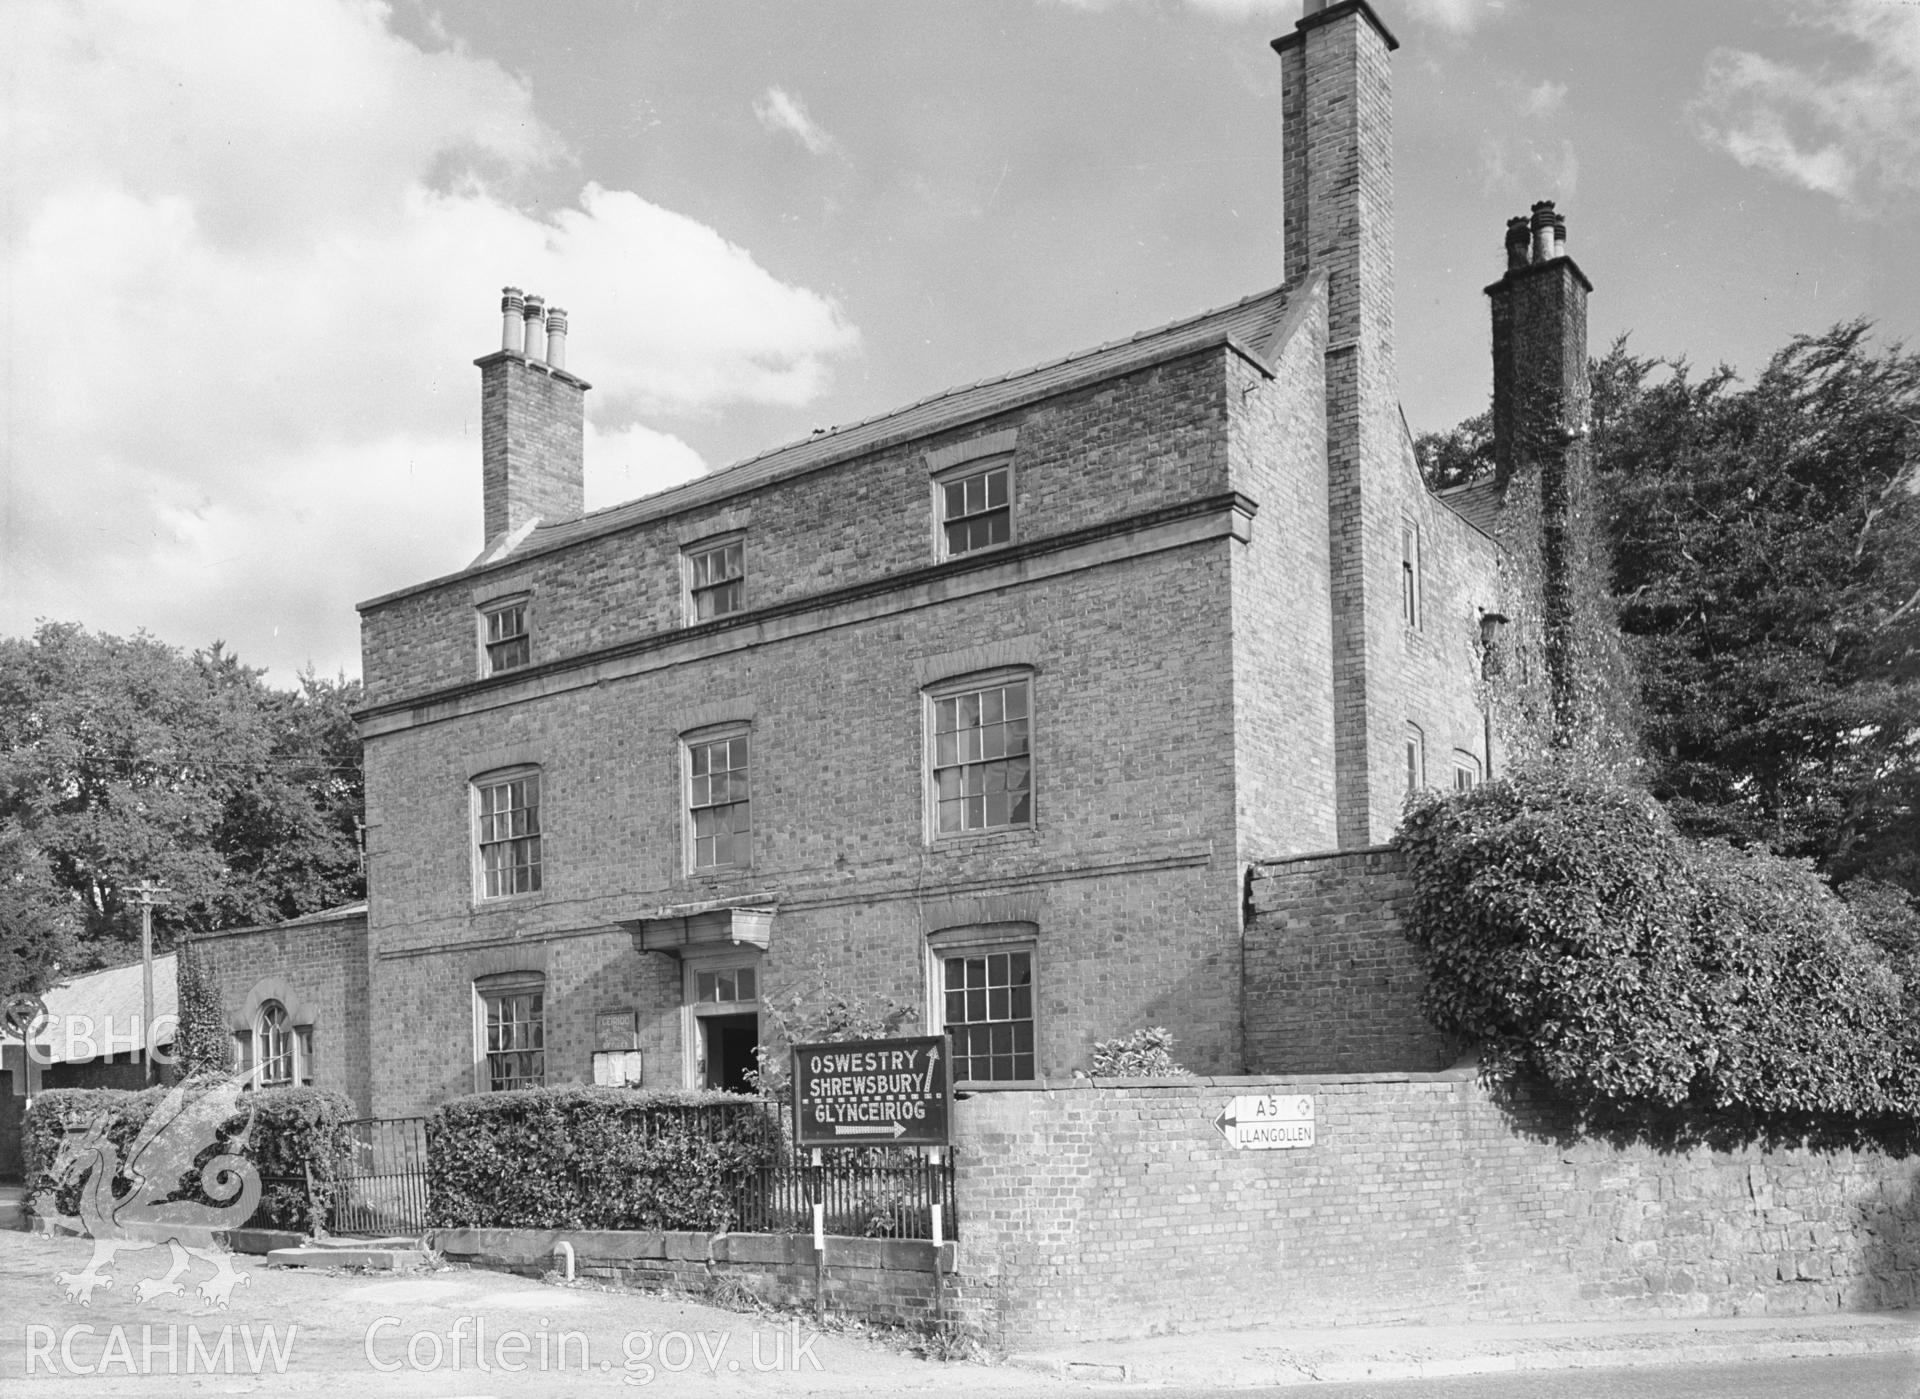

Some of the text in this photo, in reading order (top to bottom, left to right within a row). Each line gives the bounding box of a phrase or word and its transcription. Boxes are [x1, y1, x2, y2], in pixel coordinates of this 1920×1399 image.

[810, 1049, 918, 1074] OSWESTRY
[810, 1073, 924, 1097] SHREWSBURY
[815, 1100, 926, 1123] GLYNCEIRIOG
[1240, 1127, 1312, 1143] LLANGOLLEN
